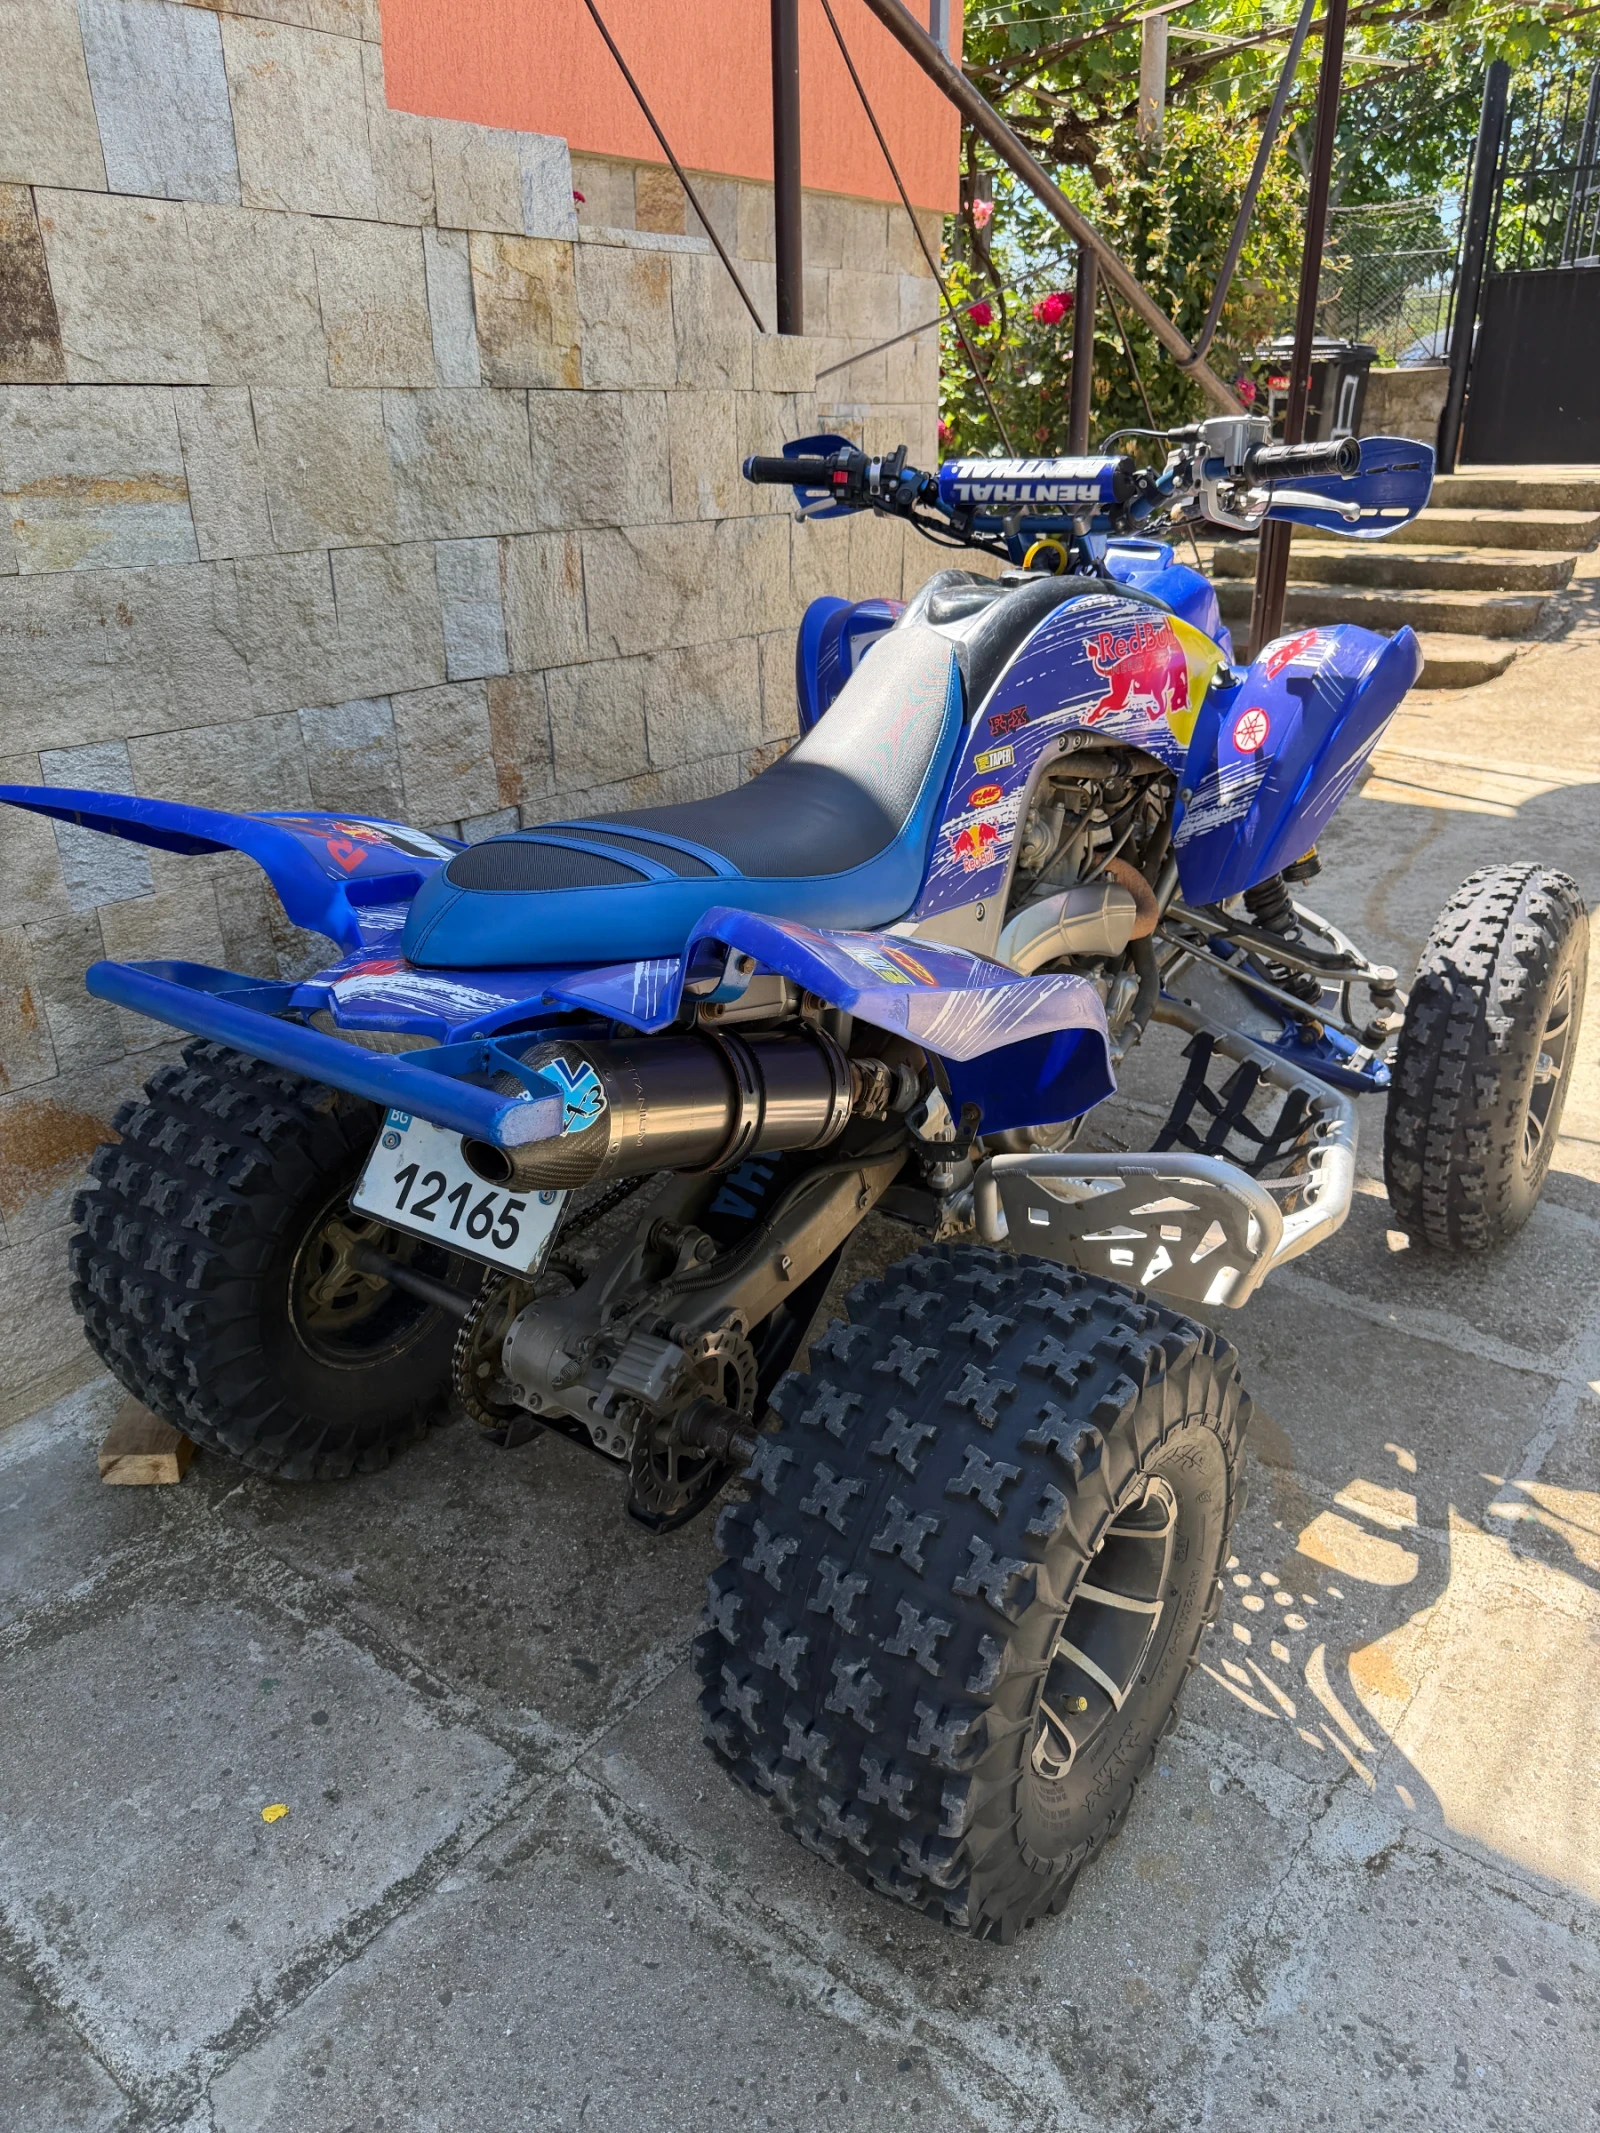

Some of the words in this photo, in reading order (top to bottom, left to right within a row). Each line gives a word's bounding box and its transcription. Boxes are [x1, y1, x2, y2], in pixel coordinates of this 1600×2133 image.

[957, 460, 1105, 479] RENTHAL
[953, 484, 1101, 502] RENTHAL
[1098, 623, 1142, 662] Red
[989, 748, 1011, 768] TAPER
[963, 857, 980, 873] Red
[980, 847, 994, 866] Bull
[624, 1056, 648, 1148] TITANIUM
[394, 1163, 527, 1250] 12165
